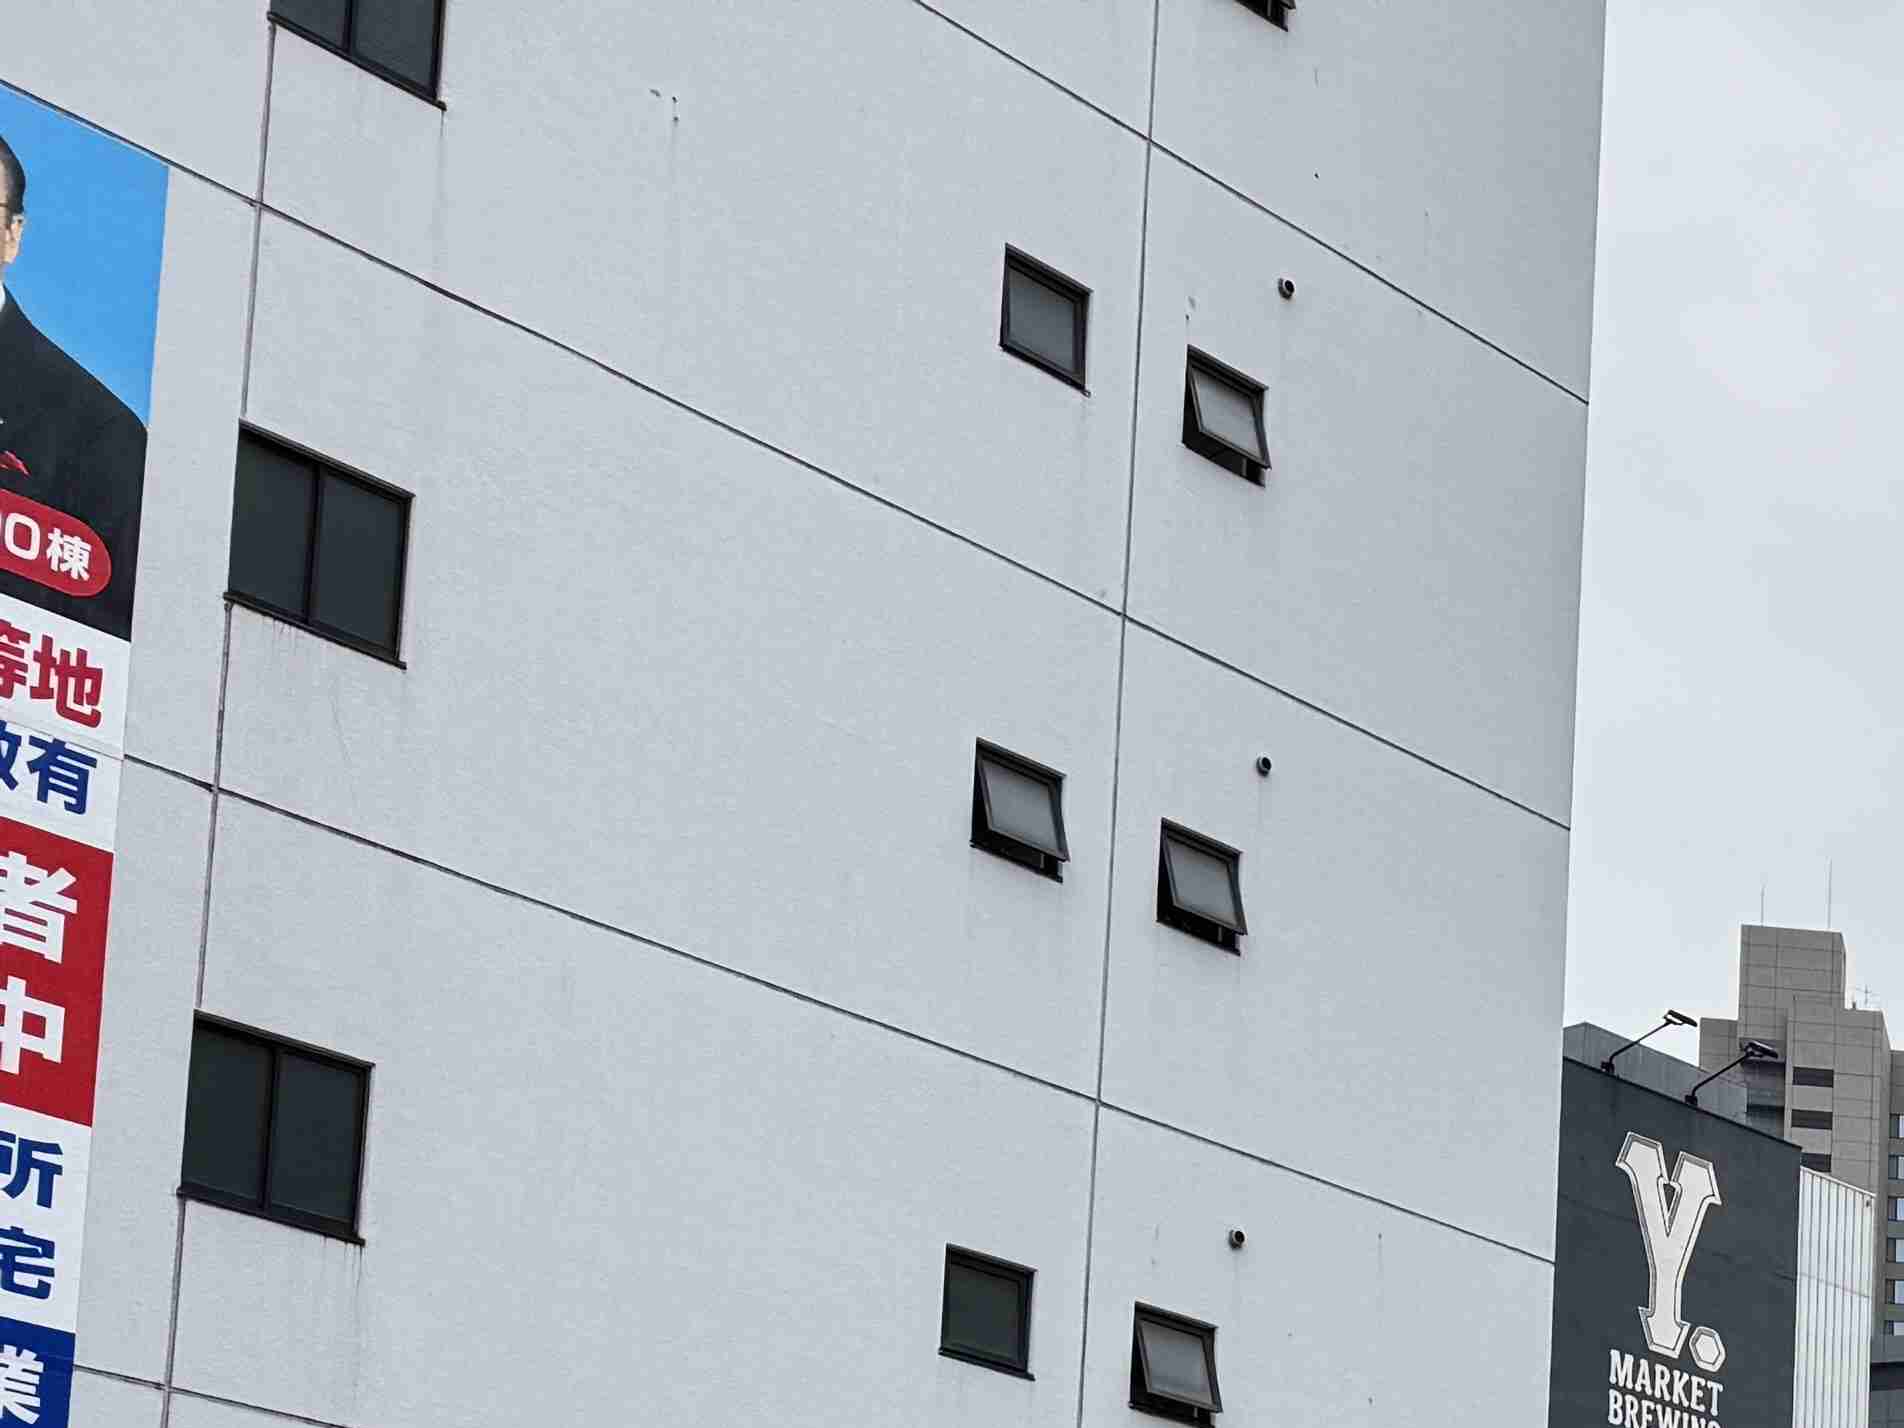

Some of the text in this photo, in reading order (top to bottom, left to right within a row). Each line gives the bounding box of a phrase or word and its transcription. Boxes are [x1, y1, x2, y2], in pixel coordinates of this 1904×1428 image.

[0, 511, 90, 581] 0棟
[0, 720, 98, 815] 有
[1609, 1348, 1724, 1417] MARKET
